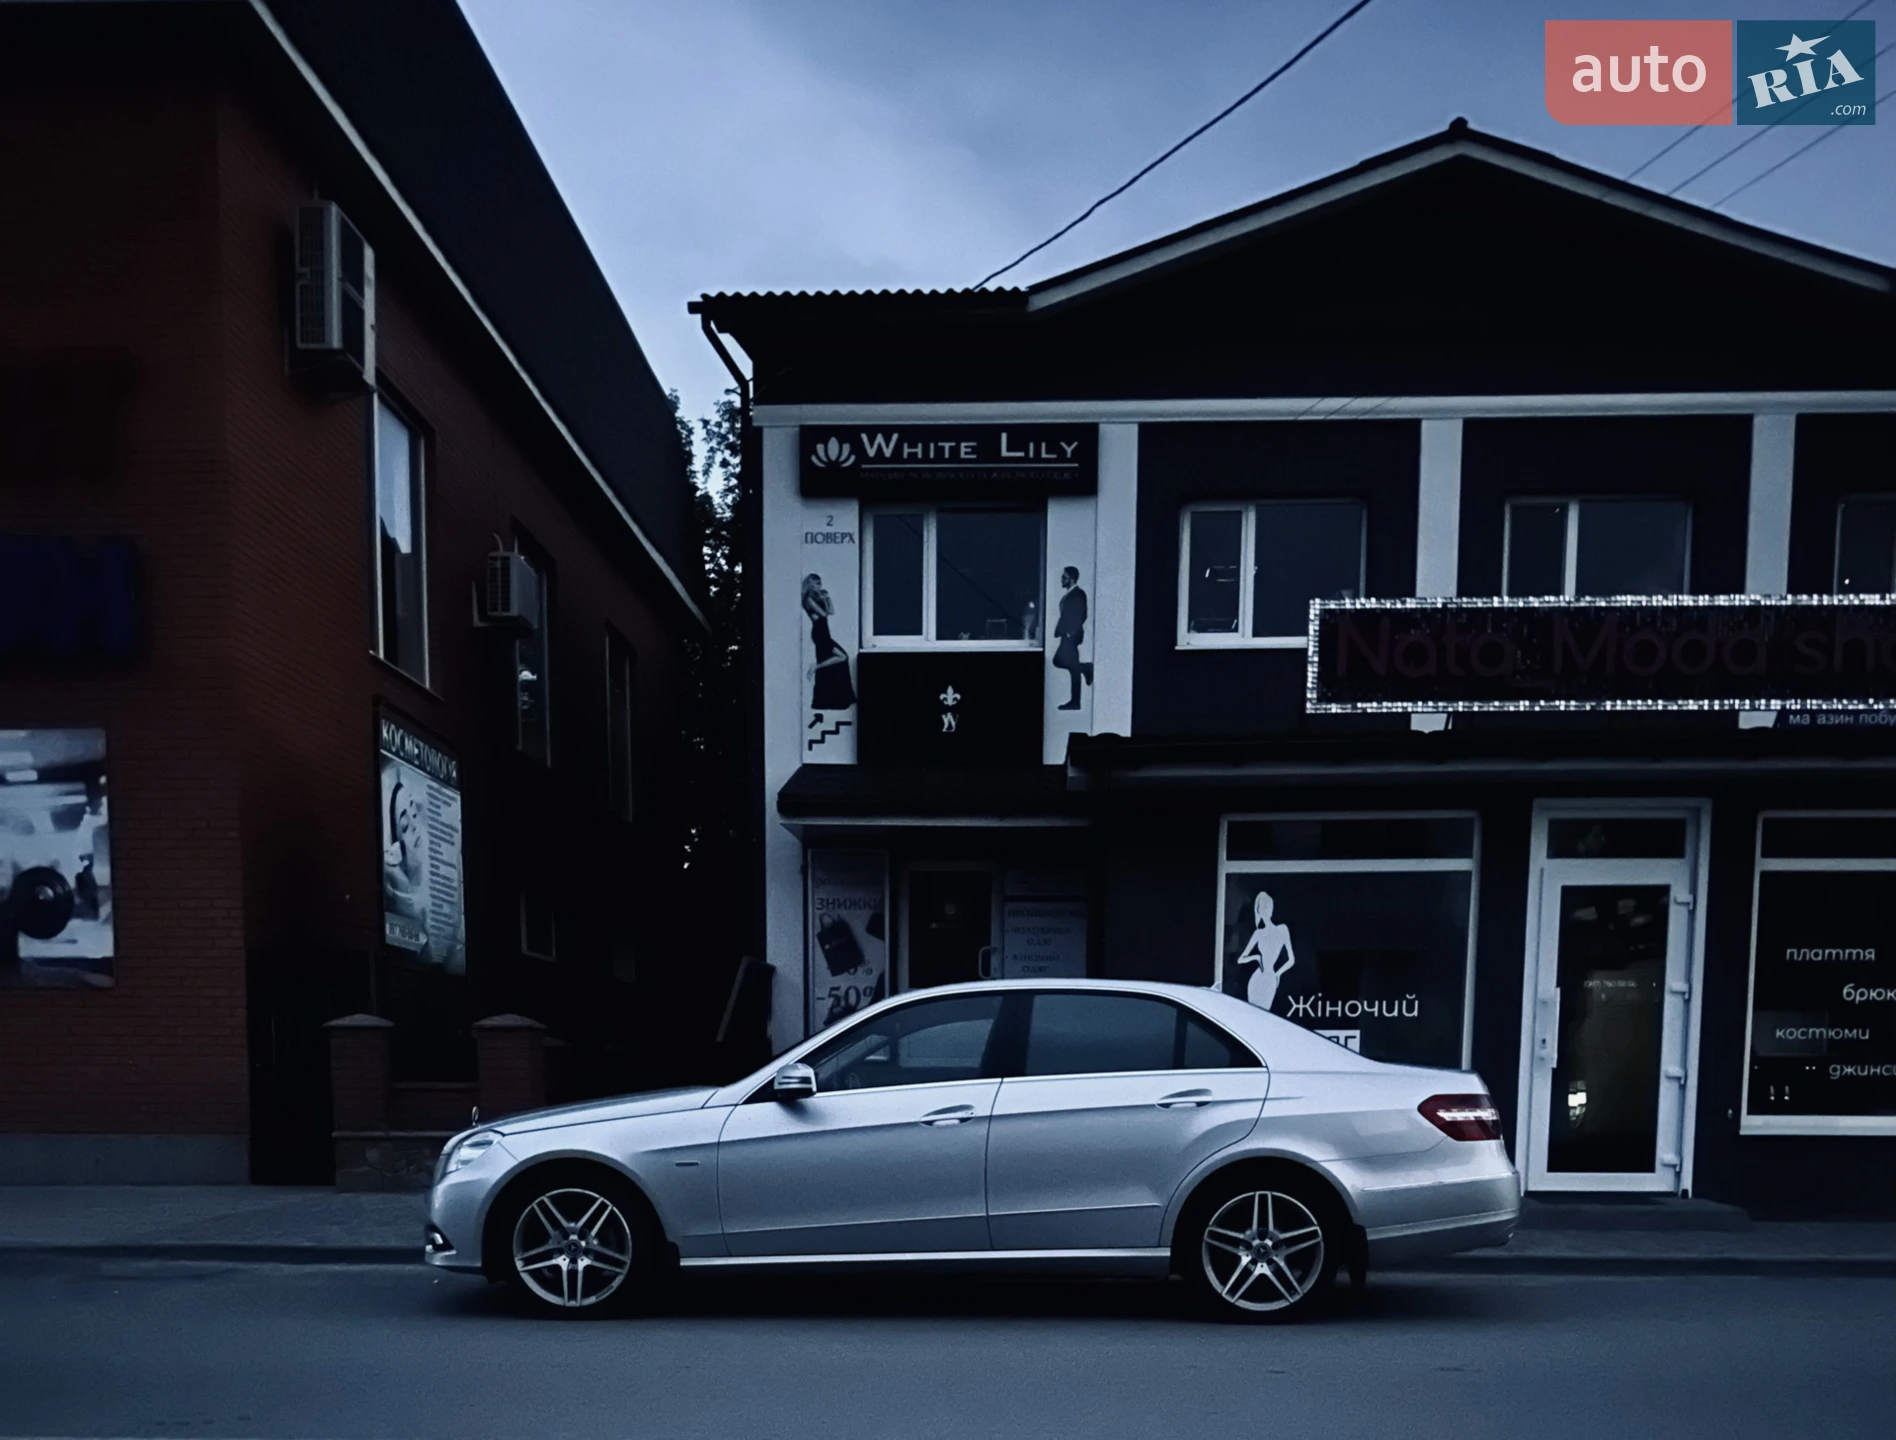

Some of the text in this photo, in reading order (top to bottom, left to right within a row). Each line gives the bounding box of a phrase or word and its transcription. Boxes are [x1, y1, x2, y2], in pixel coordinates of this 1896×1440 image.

[860, 431, 1079, 460] WHITE LILY
[826, 515, 835, 527] 2
[804, 531, 856, 545] ПОВЕРХ
[1785, 947, 1877, 962] плаття
[1286, 993, 1420, 1018] Жіночий
[1775, 1027, 1870, 1040] костюми
